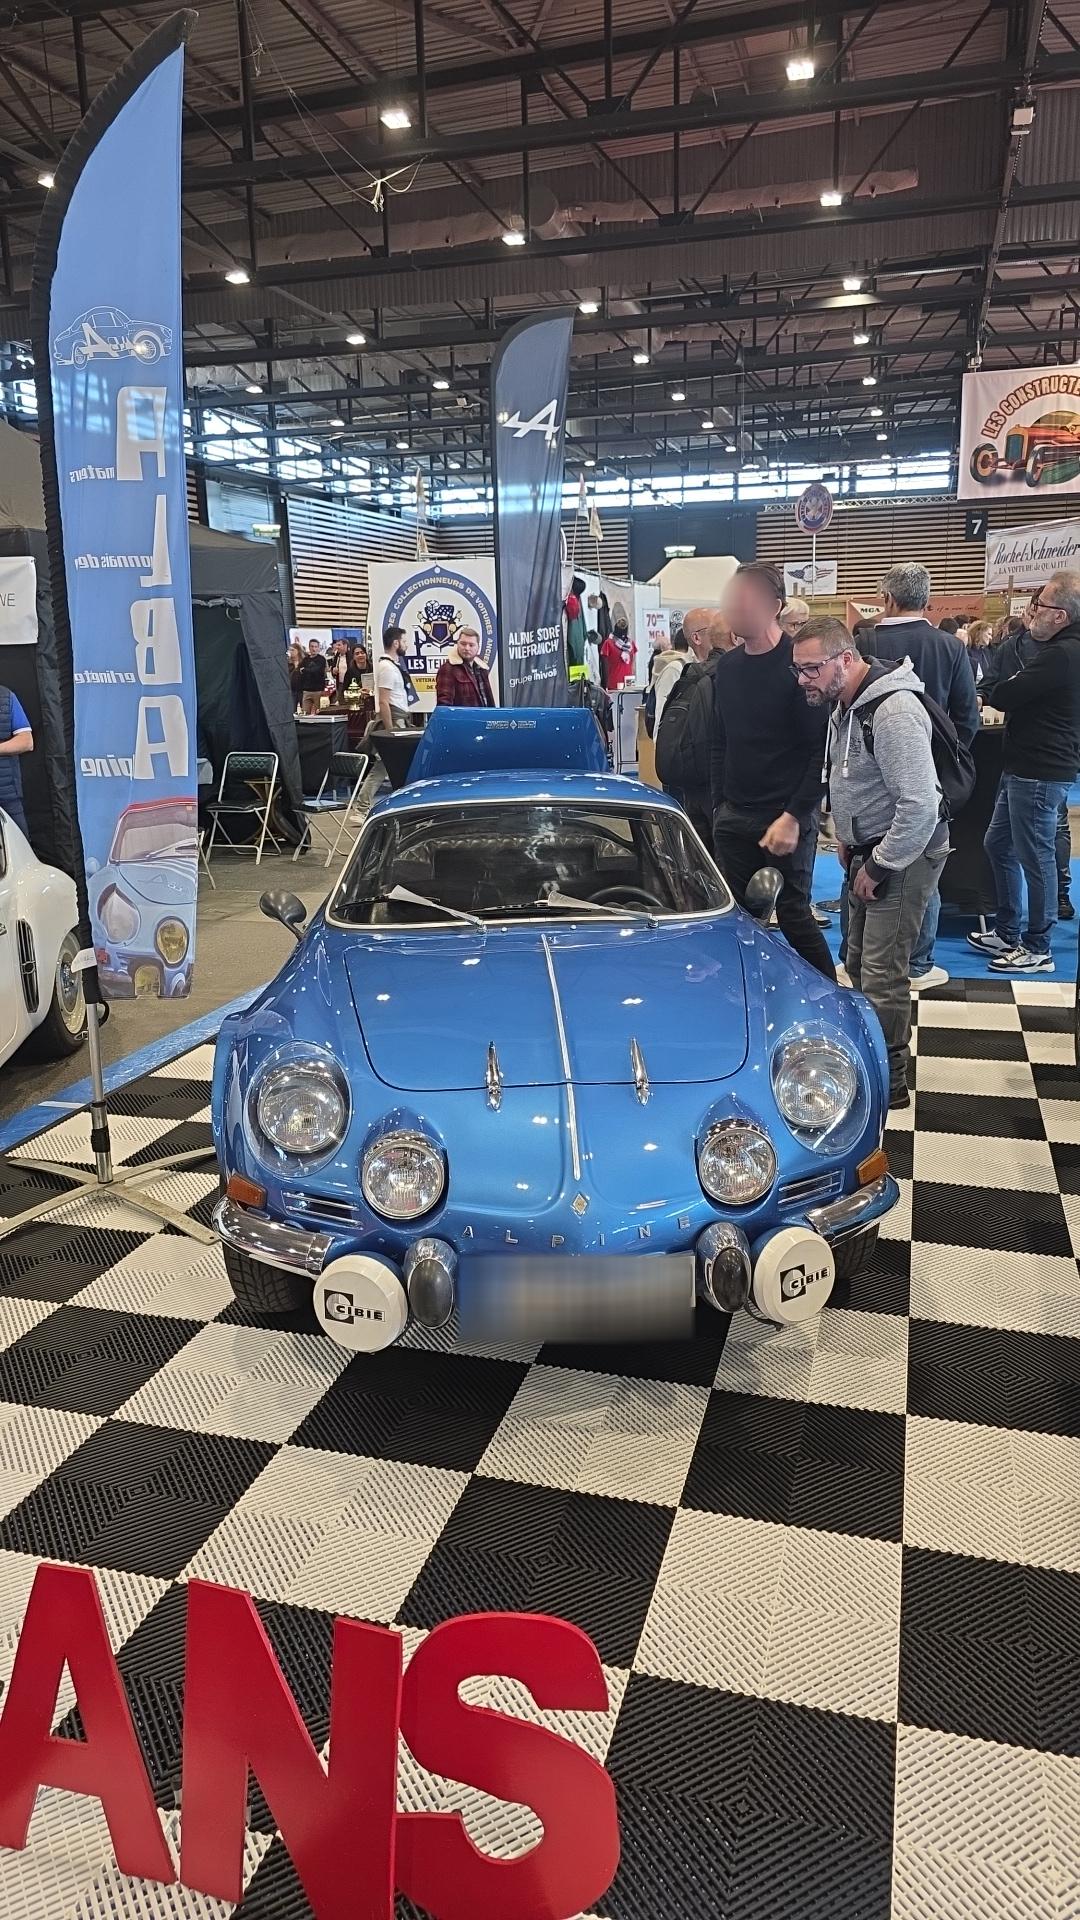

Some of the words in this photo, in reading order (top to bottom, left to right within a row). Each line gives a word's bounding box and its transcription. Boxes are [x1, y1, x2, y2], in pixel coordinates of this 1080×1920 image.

[981, 411, 1007, 439] LES
[971, 519, 982, 535] 7
[394, 577, 465, 610] COLLECTIONNEURS
[465, 587, 477, 598] DE
[475, 597, 493, 635] VOITURES
[408, 659, 425, 670] LES
[462, 1215, 691, 1248] ALPINE
